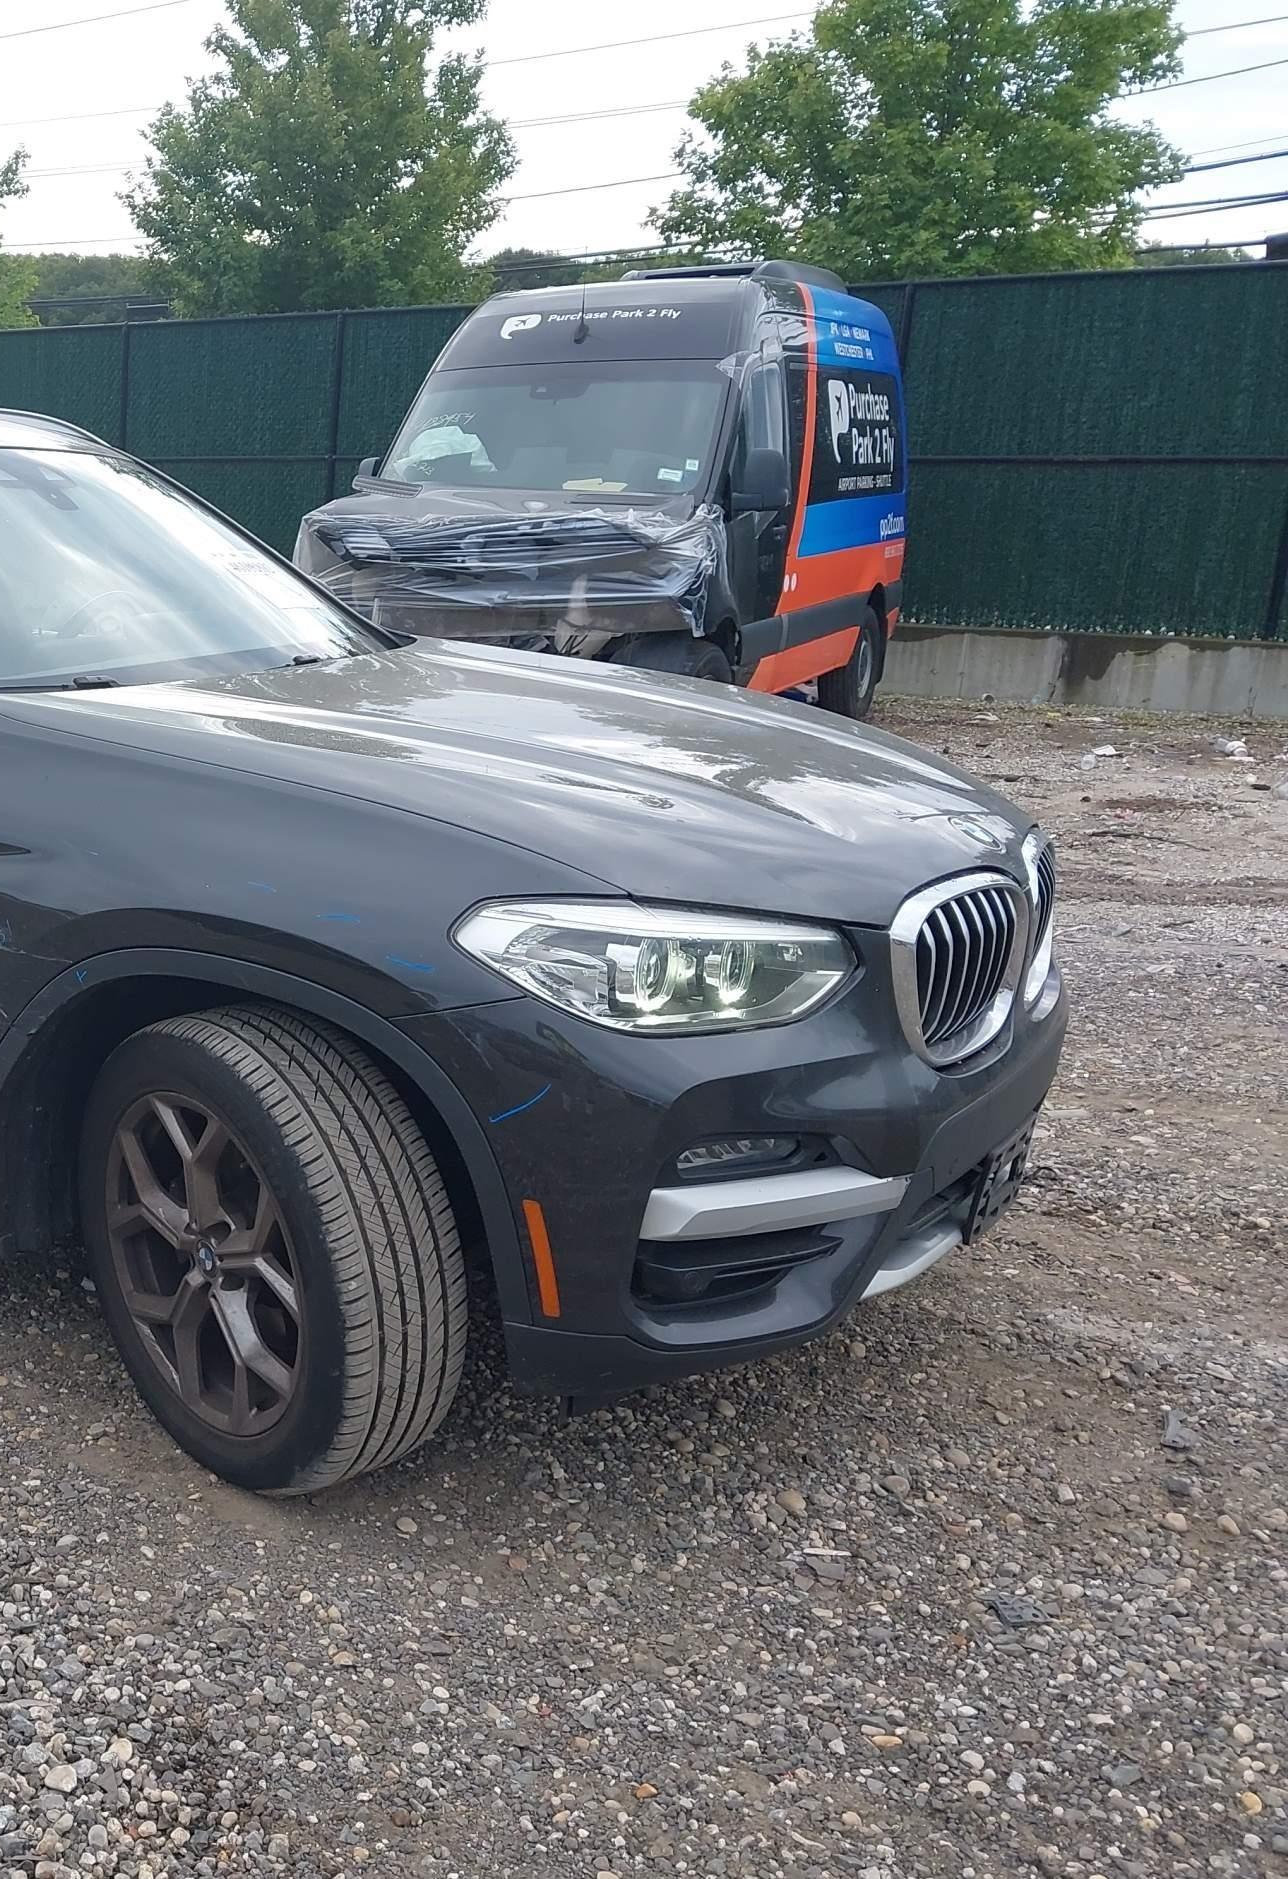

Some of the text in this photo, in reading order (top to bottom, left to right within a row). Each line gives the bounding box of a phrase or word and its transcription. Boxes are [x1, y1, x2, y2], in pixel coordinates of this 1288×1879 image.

[547, 308, 681, 322] Purchase Park 2 Fly
[848, 383, 889, 420] Purchase
[852, 425, 894, 472] Park 2 Fly
